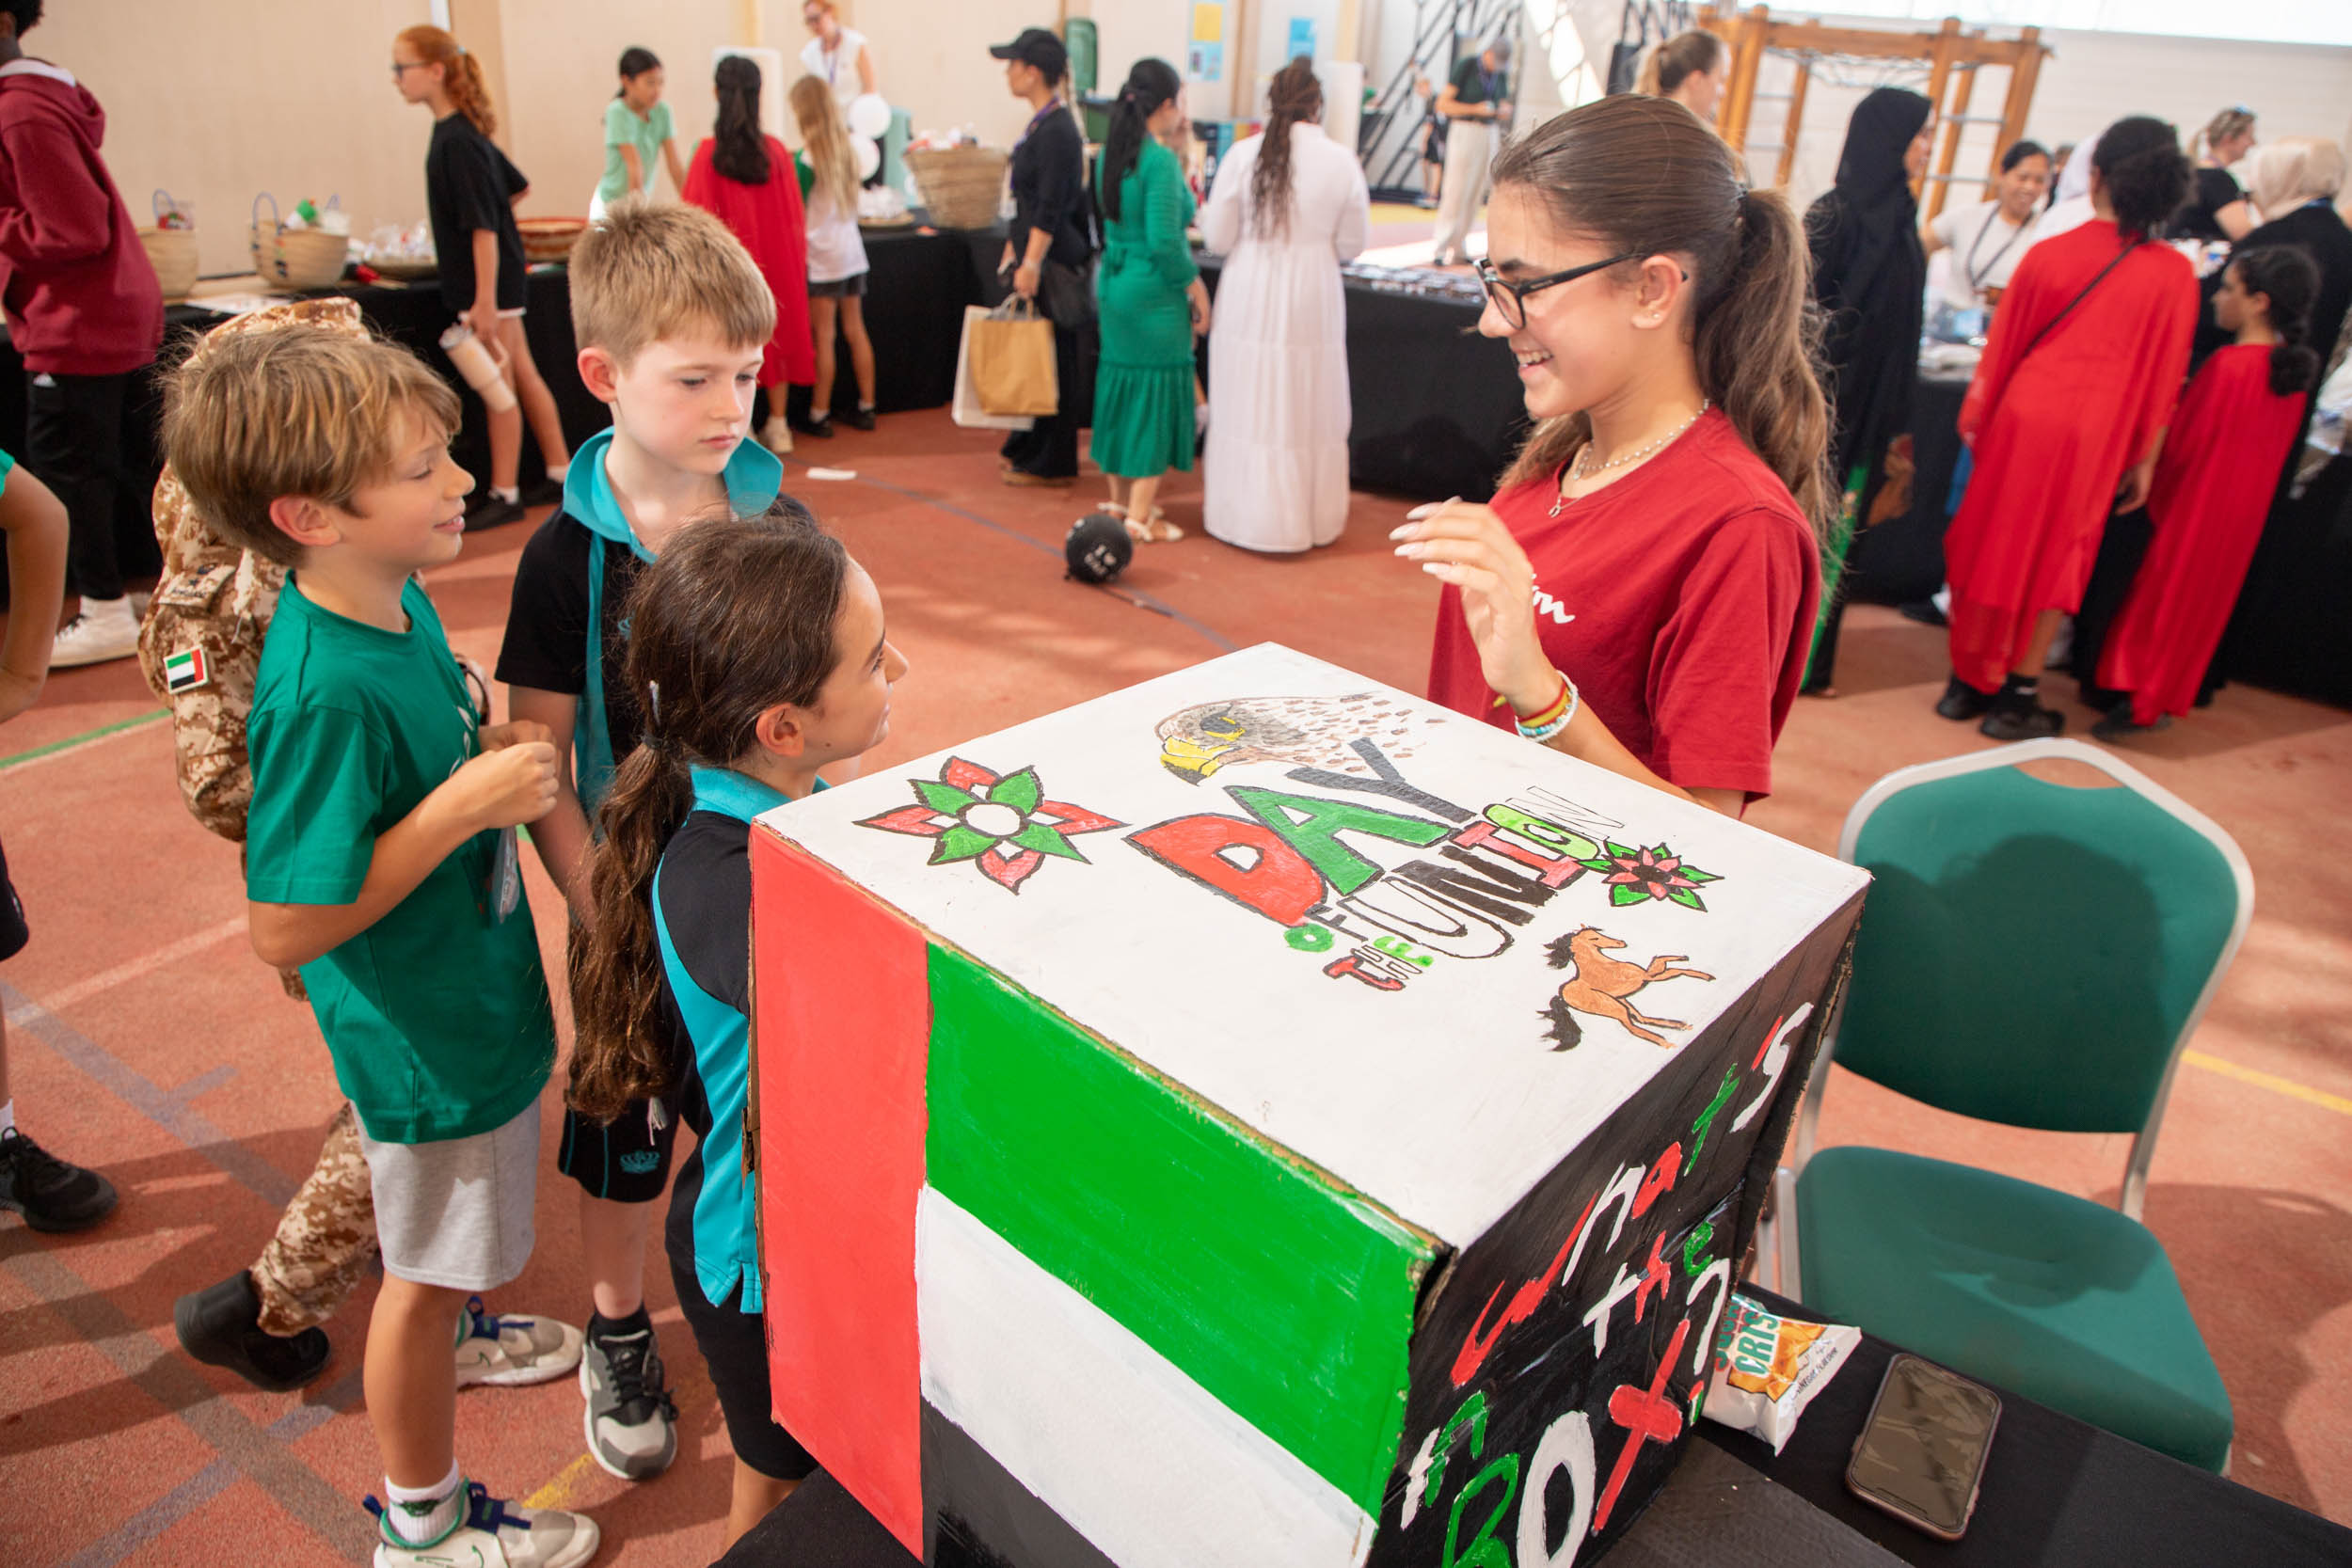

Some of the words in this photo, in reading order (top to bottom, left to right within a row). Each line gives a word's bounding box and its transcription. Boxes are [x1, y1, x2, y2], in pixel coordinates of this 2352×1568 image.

[1123, 736, 1479, 927] DAY
[1336, 785, 1626, 959] UNION
[1283, 902, 1369, 953] OF
[1323, 936, 1435, 991] THE
[1734, 1306, 1779, 1375] CRIS
